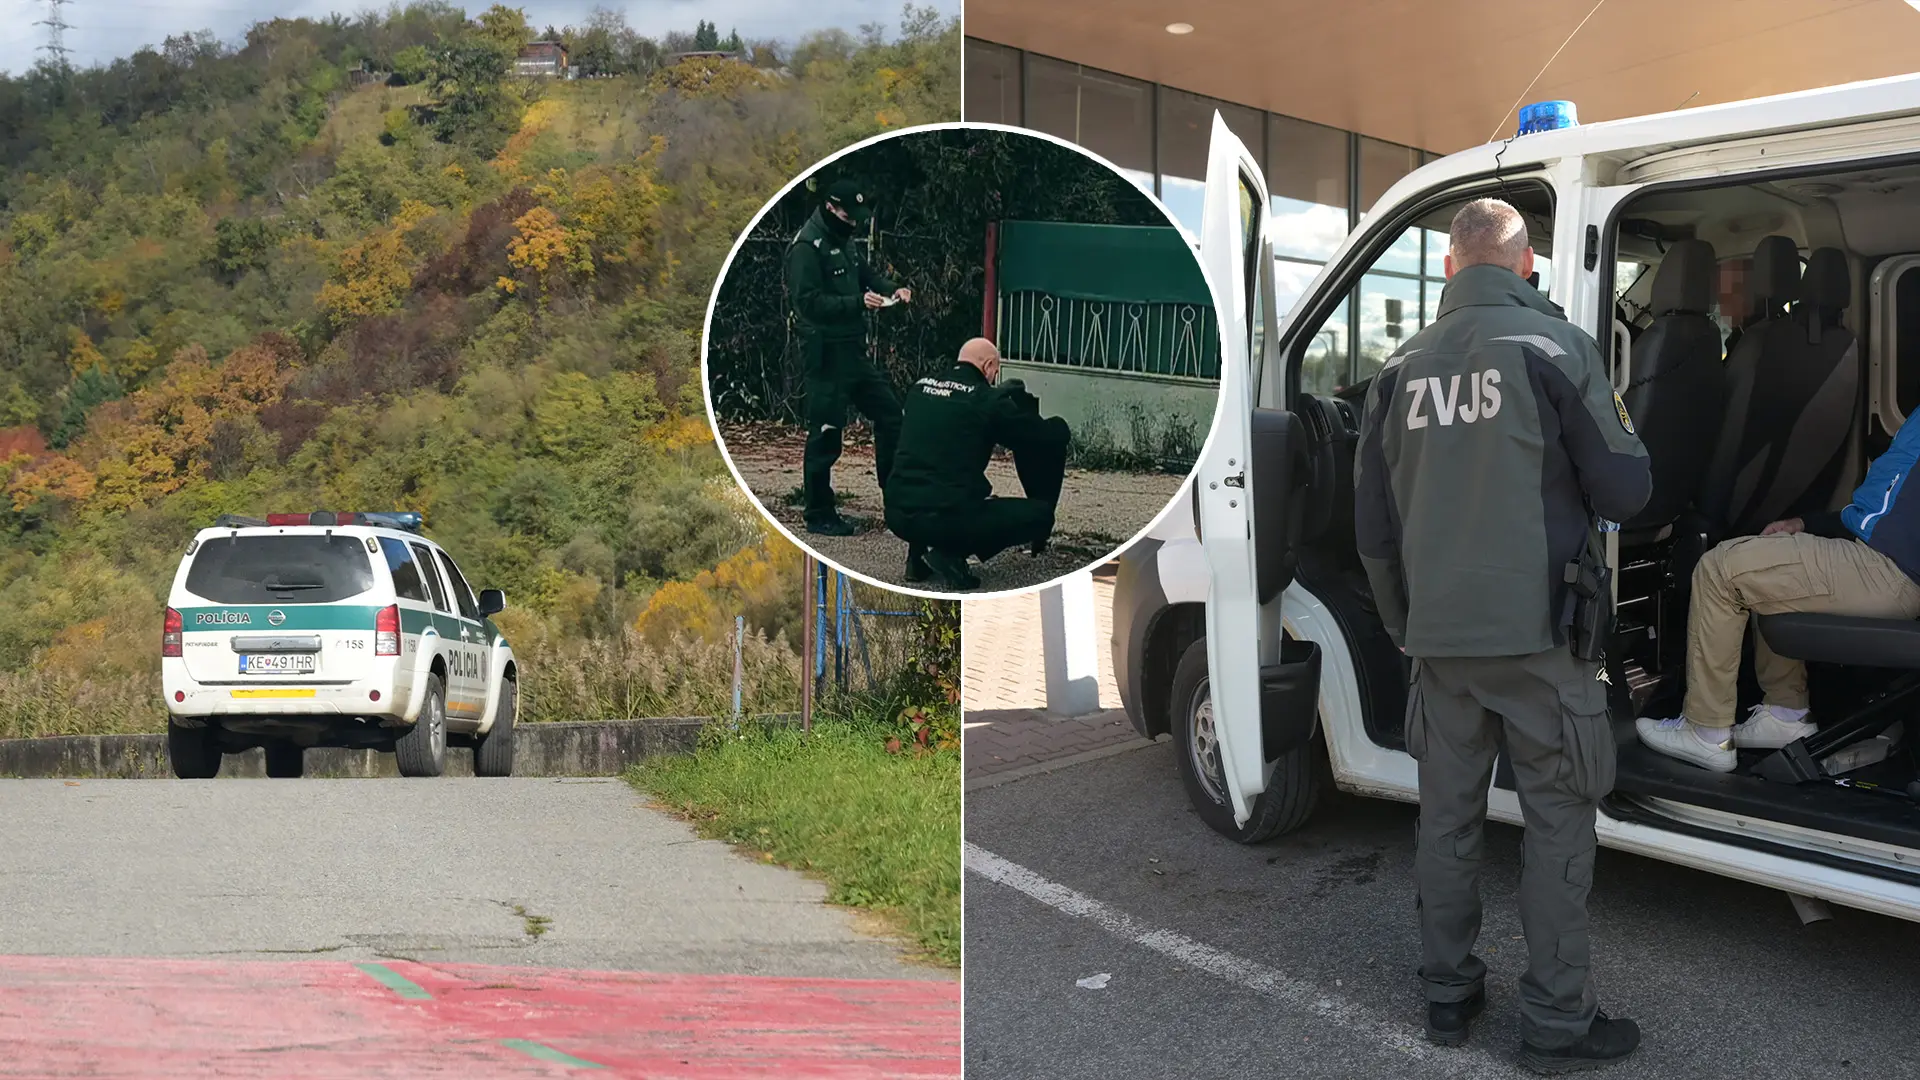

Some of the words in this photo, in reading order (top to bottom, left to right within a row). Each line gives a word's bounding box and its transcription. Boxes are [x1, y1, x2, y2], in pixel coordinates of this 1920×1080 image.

[1406, 368, 1502, 430] ZVJS
[196, 611, 251, 624] POLÍCIA
[345, 639, 364, 649] 158
[448, 644, 478, 679] POLÍCIA
